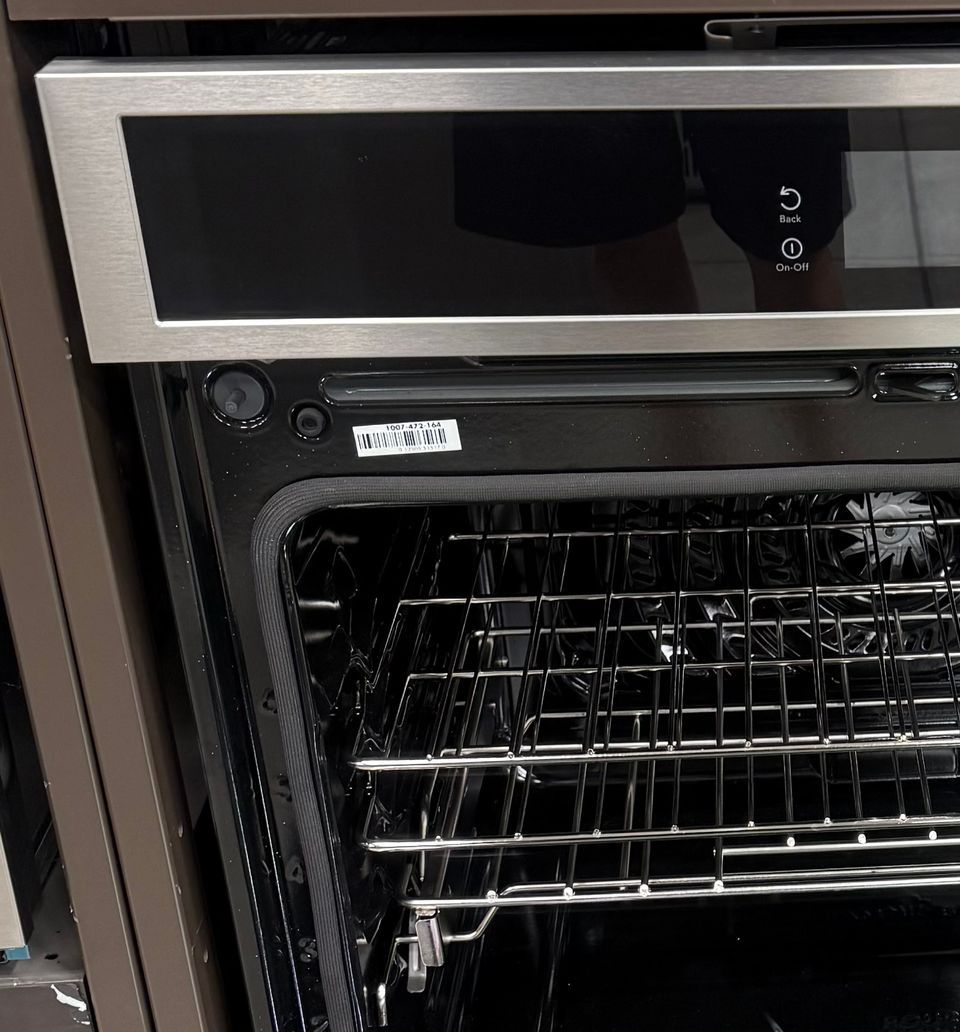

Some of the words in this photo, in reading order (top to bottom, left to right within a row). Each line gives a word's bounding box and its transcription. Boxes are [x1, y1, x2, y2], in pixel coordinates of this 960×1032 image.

[779, 214, 802, 224] Back
[776, 262, 810, 272] On-Off
[386, 422, 442, 431] 1007-472-164
